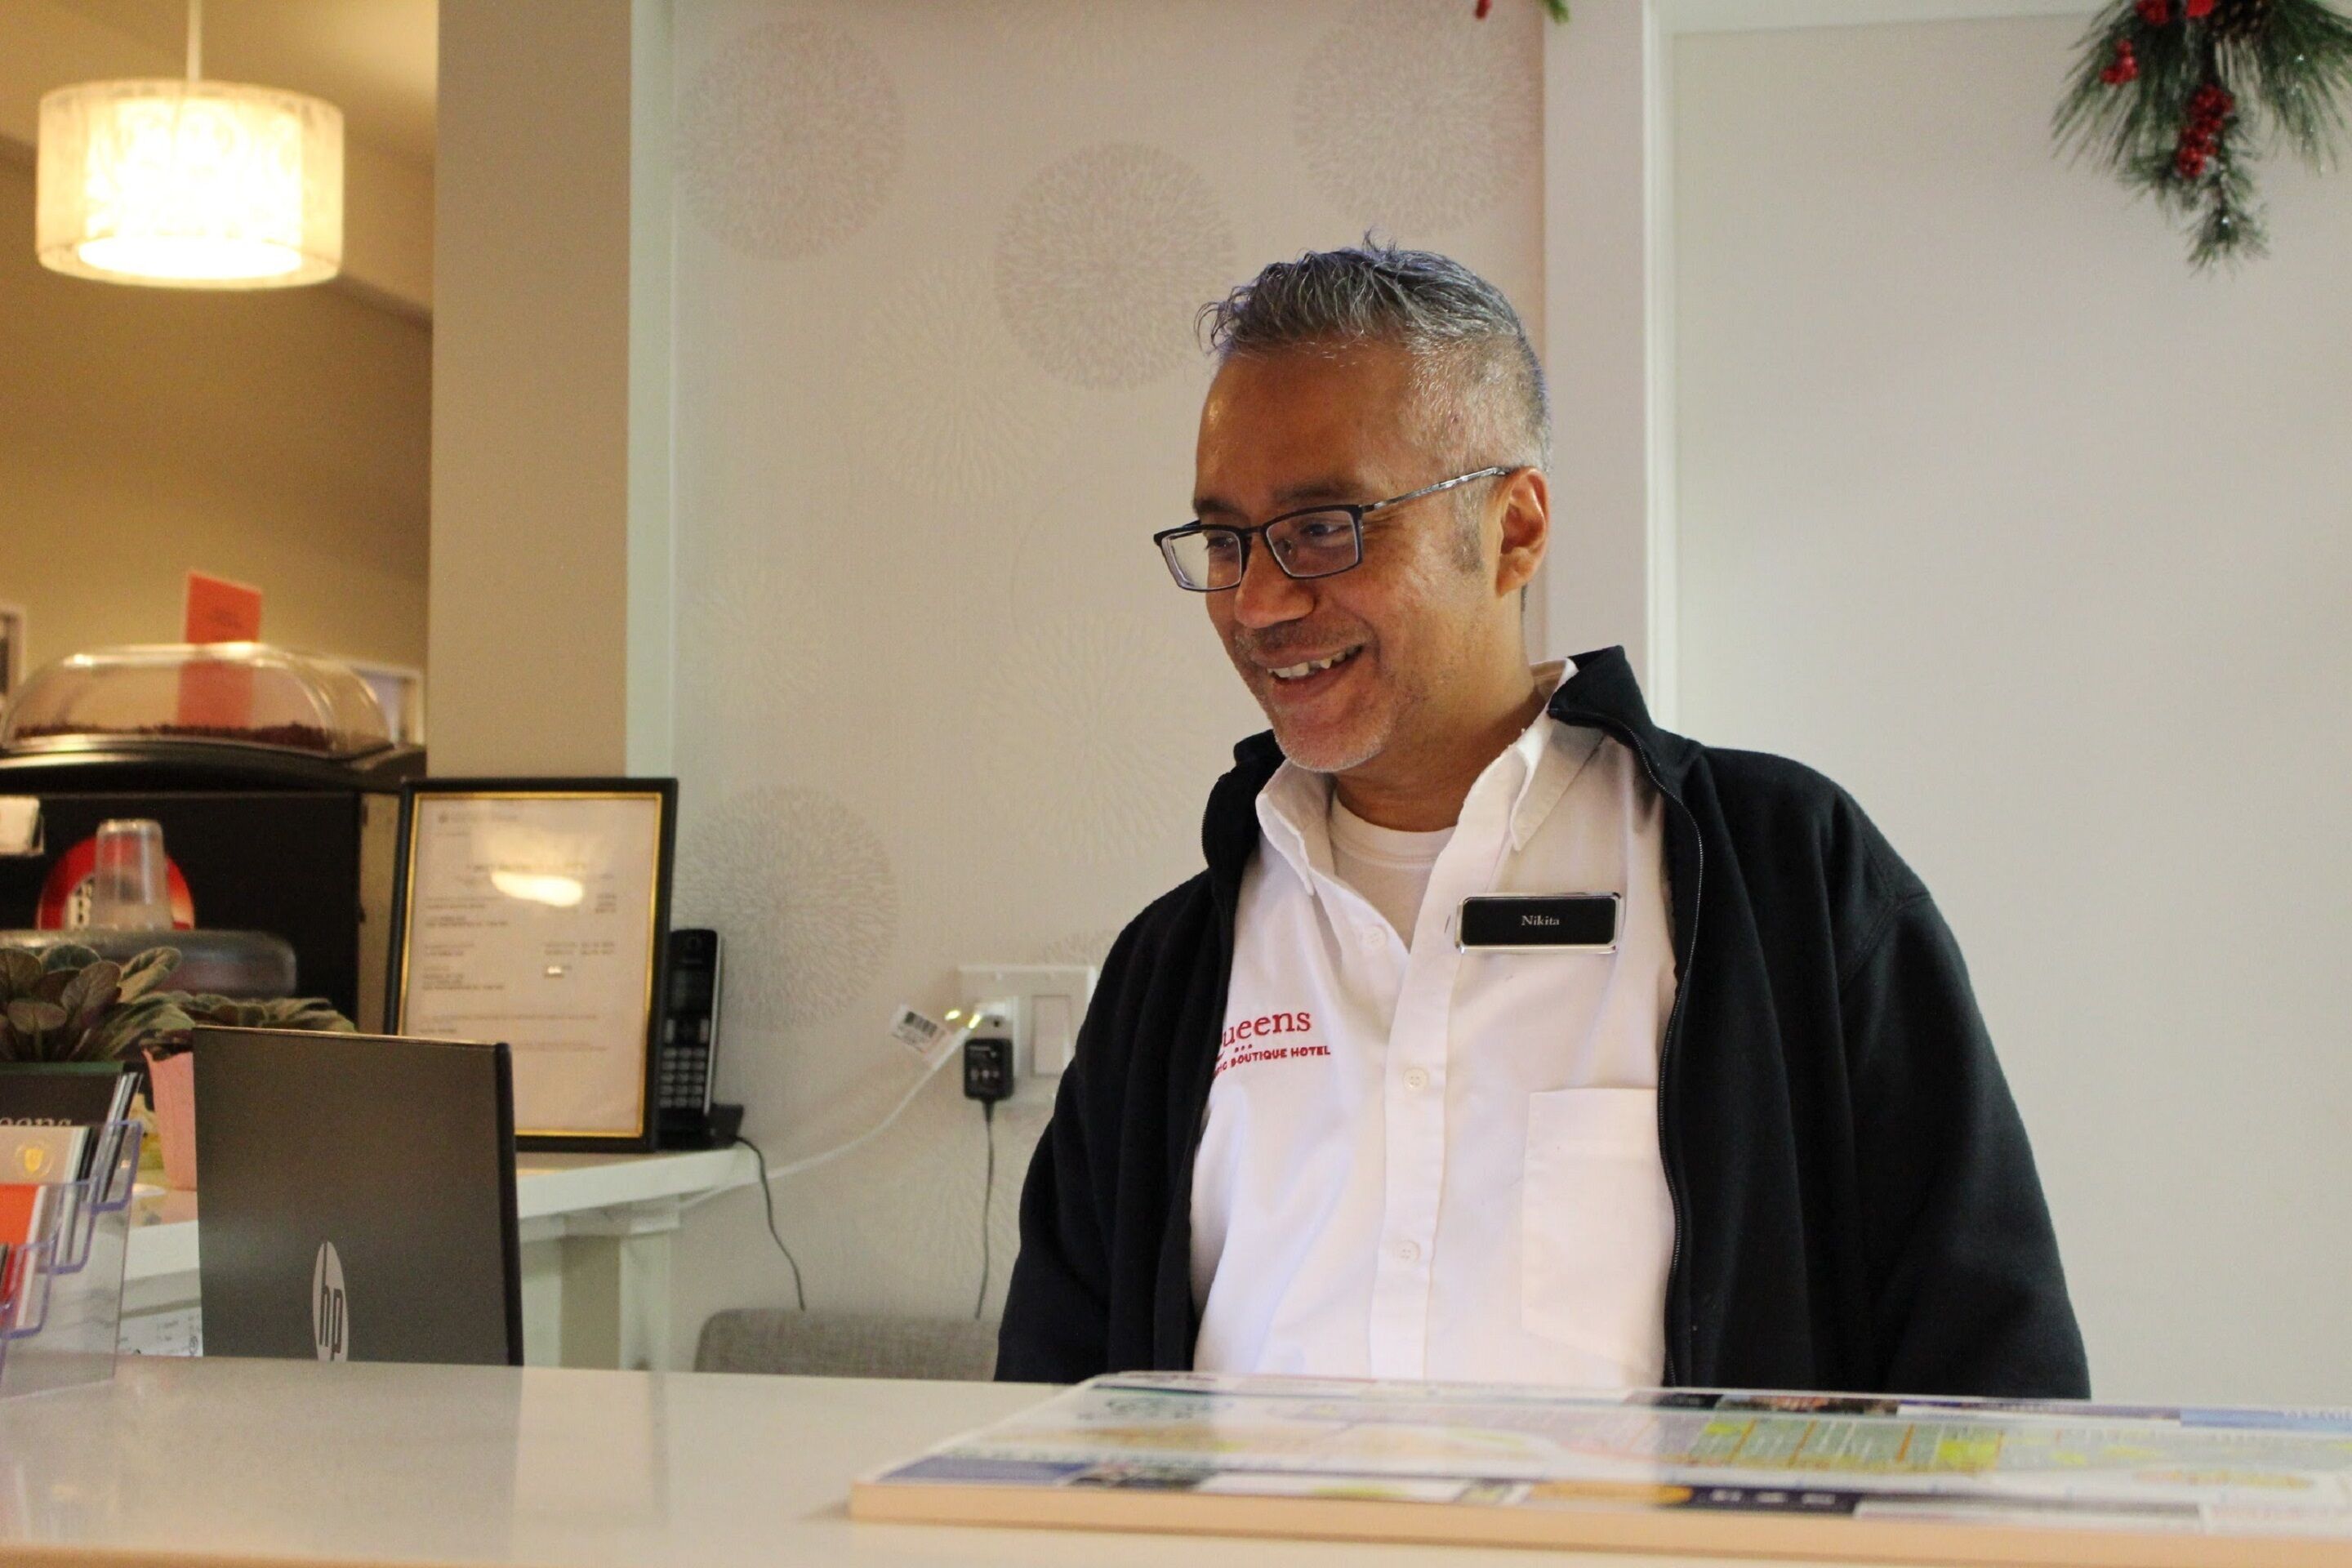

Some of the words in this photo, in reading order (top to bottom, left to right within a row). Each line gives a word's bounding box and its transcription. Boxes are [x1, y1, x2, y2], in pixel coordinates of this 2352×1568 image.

[1521, 915, 1560, 926] Nikita
[1223, 1012, 1312, 1049] ueens
[1231, 1048, 1288, 1067] BOUTIQUE
[1290, 1045, 1331, 1058] HOTEL
[319, 1242, 344, 1361] hp
